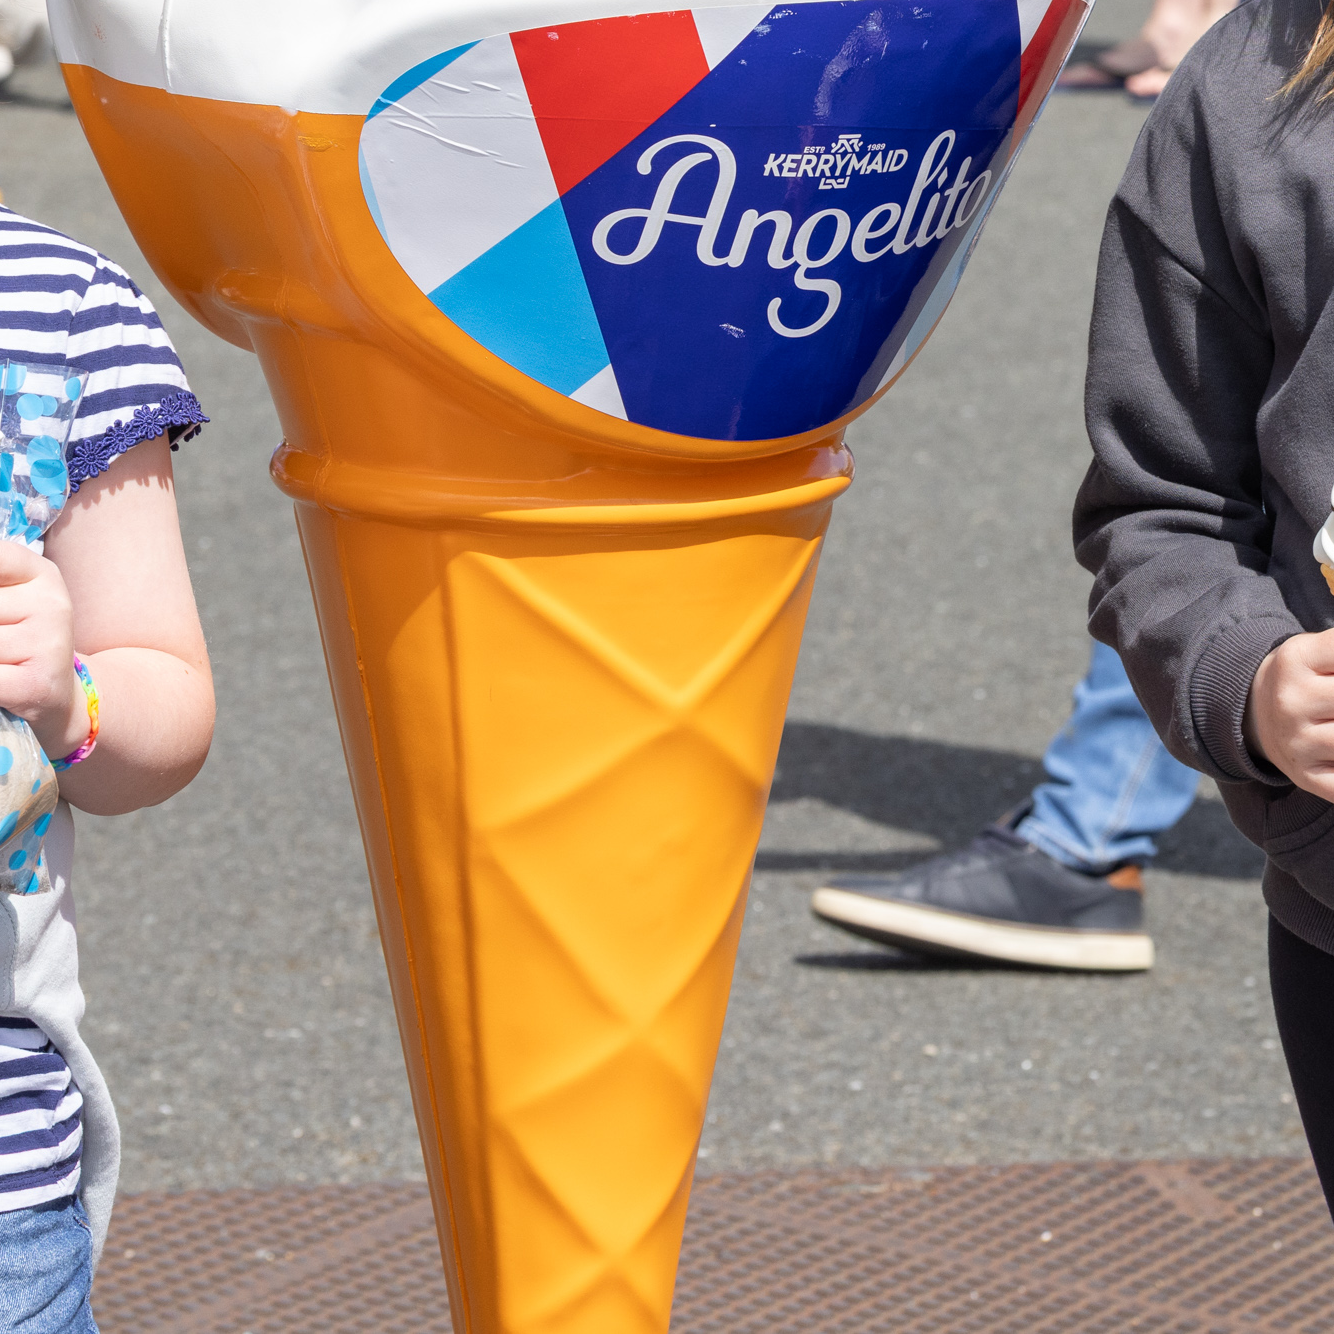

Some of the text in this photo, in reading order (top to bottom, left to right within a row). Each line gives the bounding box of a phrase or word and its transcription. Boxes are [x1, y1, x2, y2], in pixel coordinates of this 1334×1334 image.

[867, 143, 886, 152] 1989
[763, 149, 909, 177] KERRYMAID
[592, 130, 993, 338] Angelito
